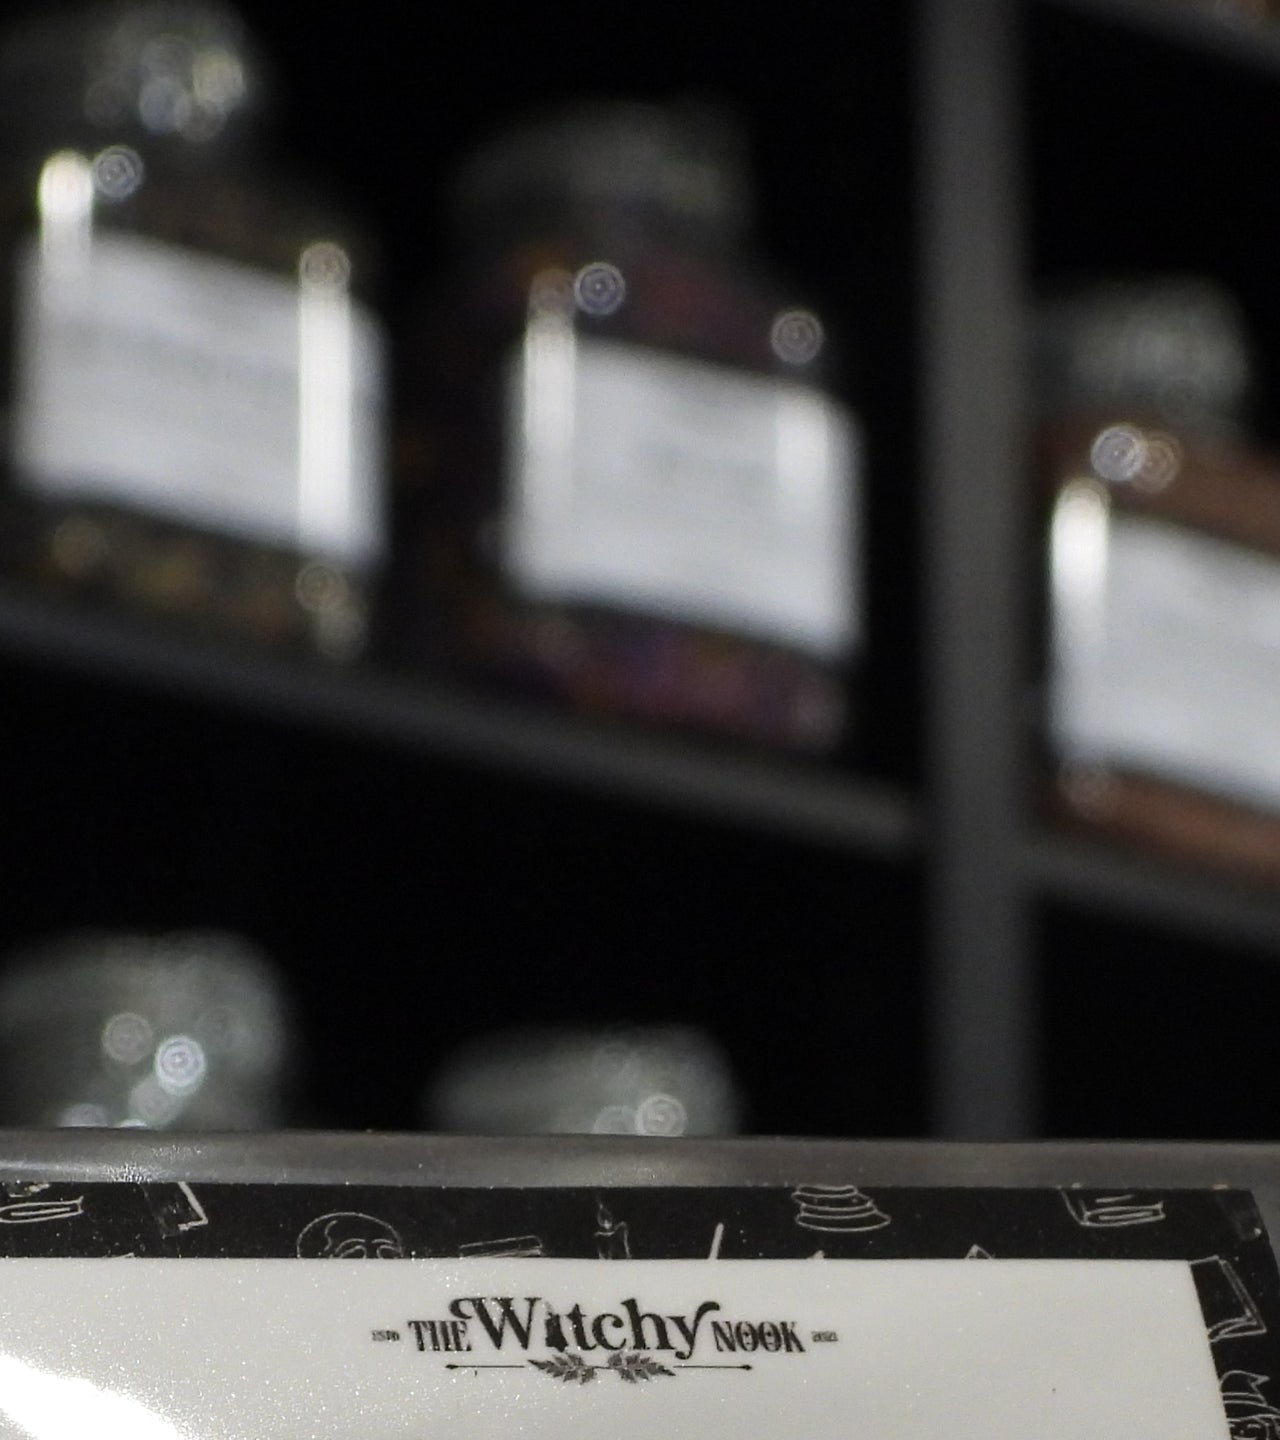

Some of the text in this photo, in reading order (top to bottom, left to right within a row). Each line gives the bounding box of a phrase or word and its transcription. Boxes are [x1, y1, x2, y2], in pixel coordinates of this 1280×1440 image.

[406, 1319, 473, 1352] THE
[448, 1297, 721, 1360] Witchy
[710, 1320, 806, 1353] NOOK
